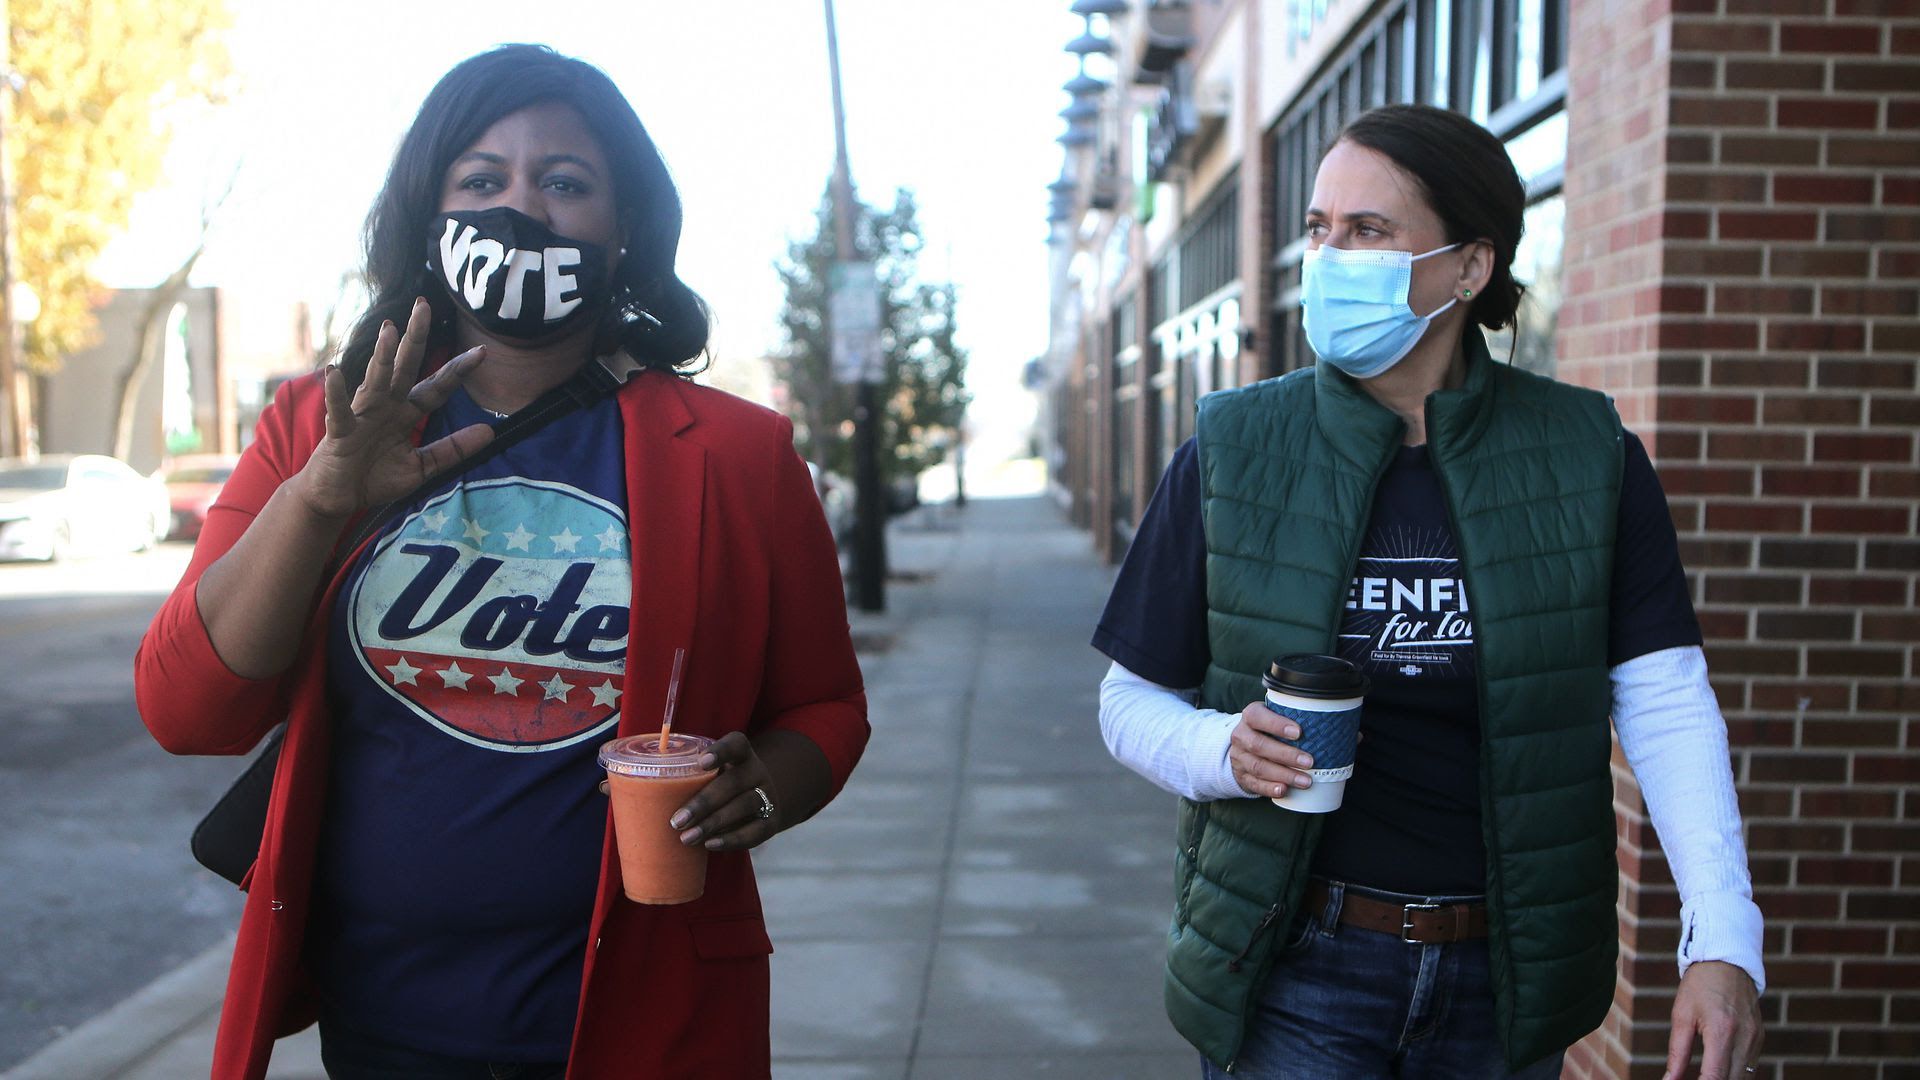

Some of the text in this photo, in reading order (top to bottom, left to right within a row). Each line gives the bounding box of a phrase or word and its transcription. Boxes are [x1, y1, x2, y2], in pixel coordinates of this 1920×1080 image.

[440, 218, 582, 324] VOTE
[378, 543, 630, 663] Vote
[1377, 613, 1428, 650] for
